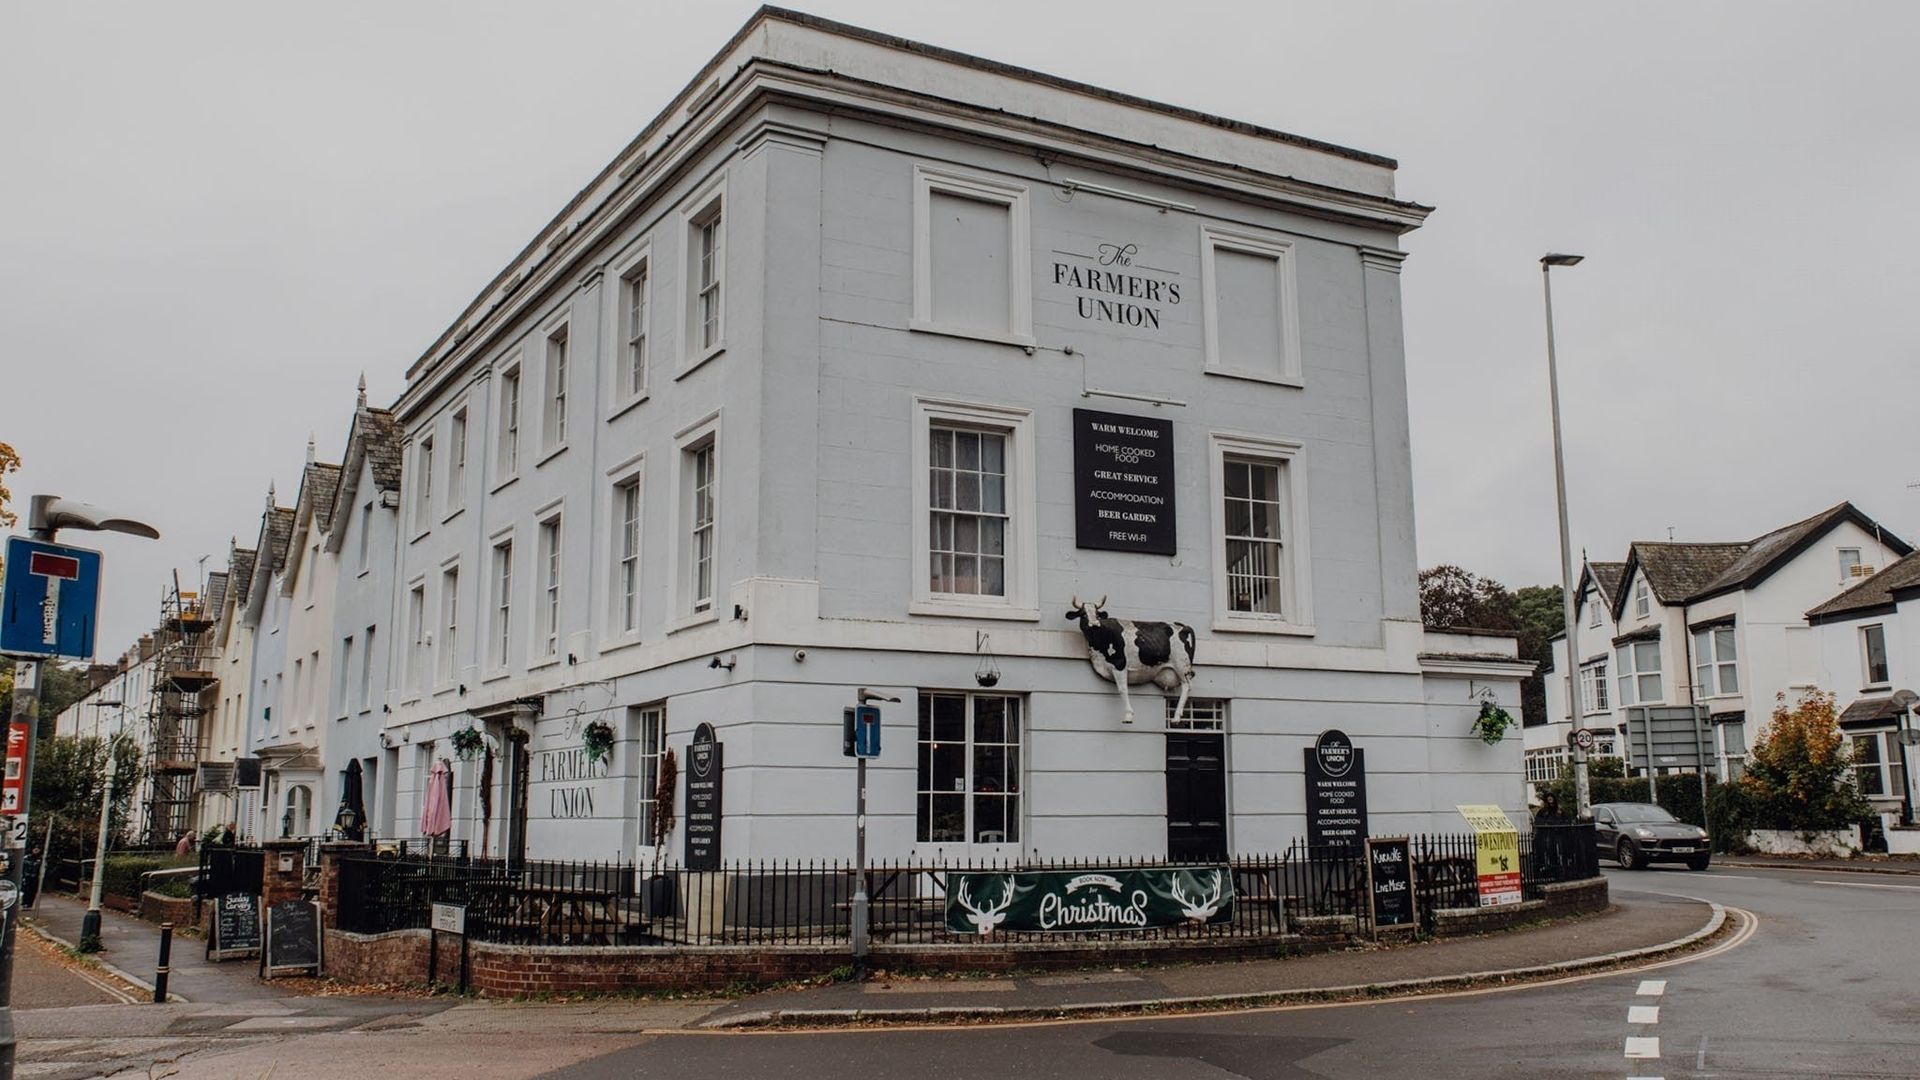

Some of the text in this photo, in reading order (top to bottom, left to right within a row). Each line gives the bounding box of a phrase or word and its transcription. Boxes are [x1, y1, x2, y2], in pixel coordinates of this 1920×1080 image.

[1098, 243, 1138, 267] The
[1052, 262, 1181, 305] FARMER'S
[1076, 296, 1160, 330] UNION
[1091, 422, 1160, 439] WARM WELCOME
[1095, 443, 1156, 458] HOME COOKED
[1115, 454, 1139, 464] FOOD
[1094, 469, 1158, 485] GREAT SERVICE
[1090, 490, 1164, 505] ACCOMMODATION
[1098, 509, 1156, 523] BEER GARDEN
[1109, 531, 1147, 542] FREE WI-FI
[1579, 734, 1591, 743] 20
[542, 749, 609, 780] FARMERS
[550, 786, 596, 819] UNION
